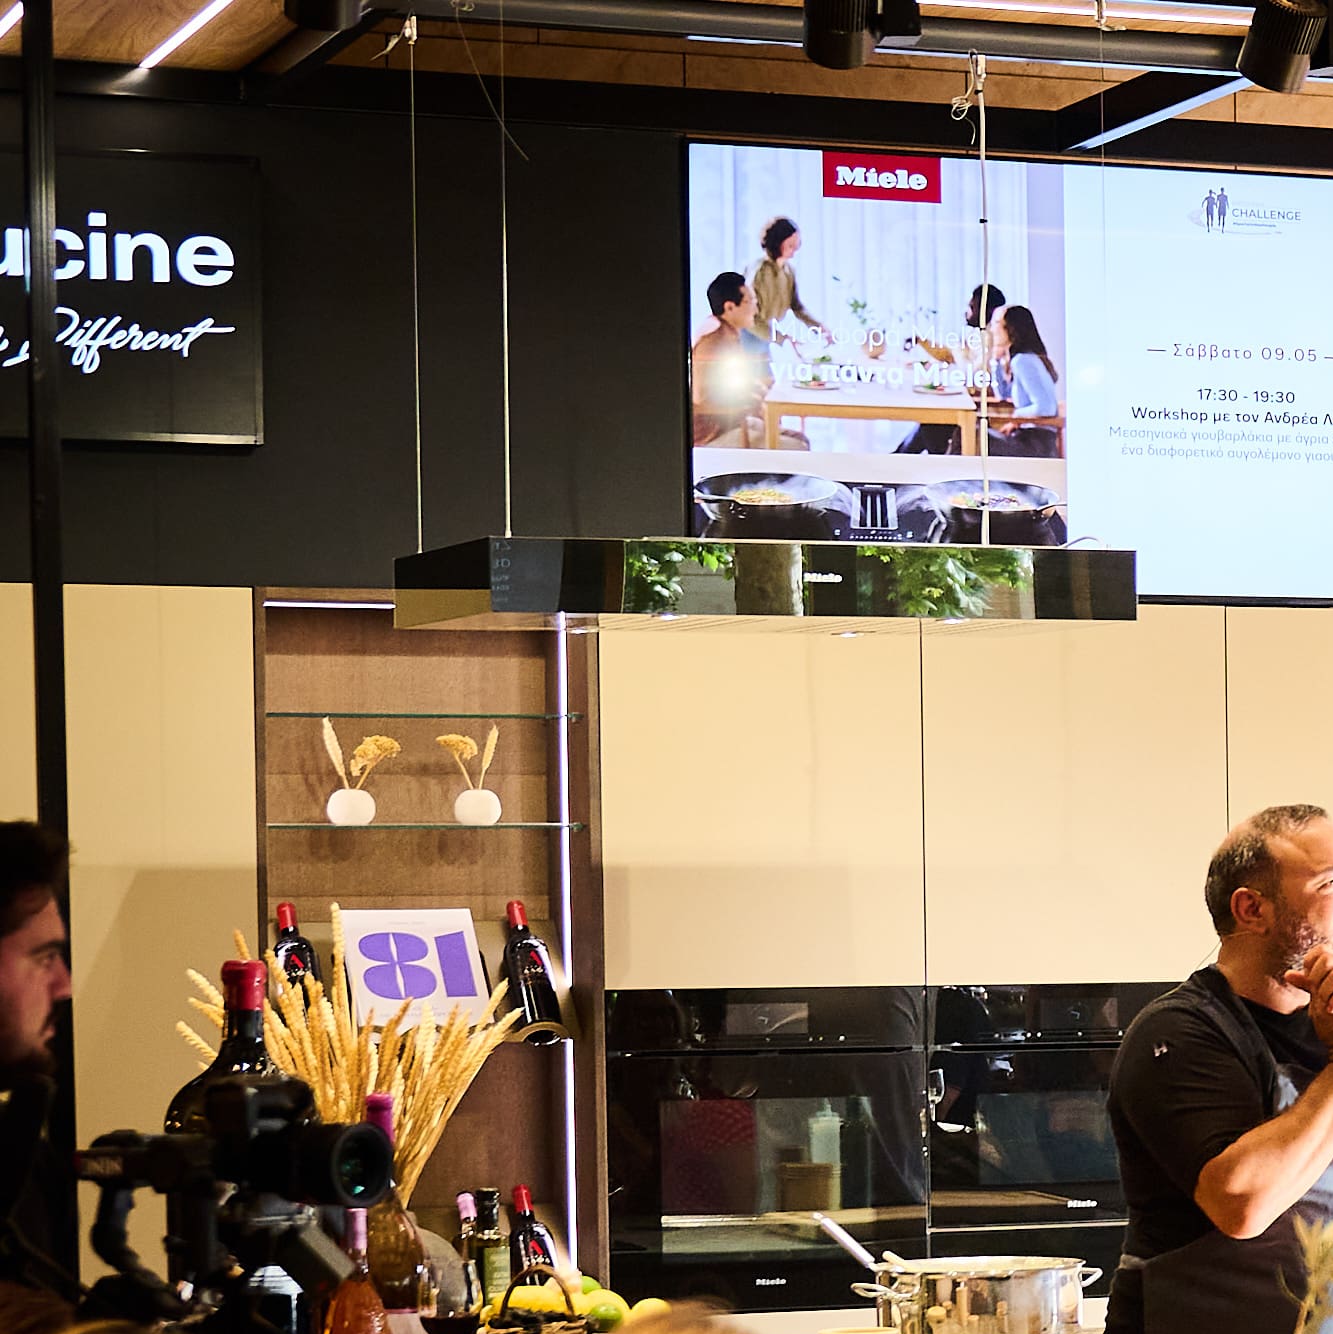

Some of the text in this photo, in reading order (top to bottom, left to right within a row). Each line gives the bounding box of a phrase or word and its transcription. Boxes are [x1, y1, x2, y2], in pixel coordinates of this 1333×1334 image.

[836, 166, 927, 190] Miele
[1232, 208, 1301, 221] CHALLENGE
[1173, 343, 1317, 362] Σάββατο 09.05
[1197, 388, 1238, 402] 17:30
[1253, 390, 1296, 404] 19:30
[1131, 406, 1208, 424] Workshop
[1213, 412, 1231, 424] με
[1235, 413, 1259, 423] τον
[1264, 411, 1318, 427] Ανδρέα
[358, 931, 478, 1000] 81
